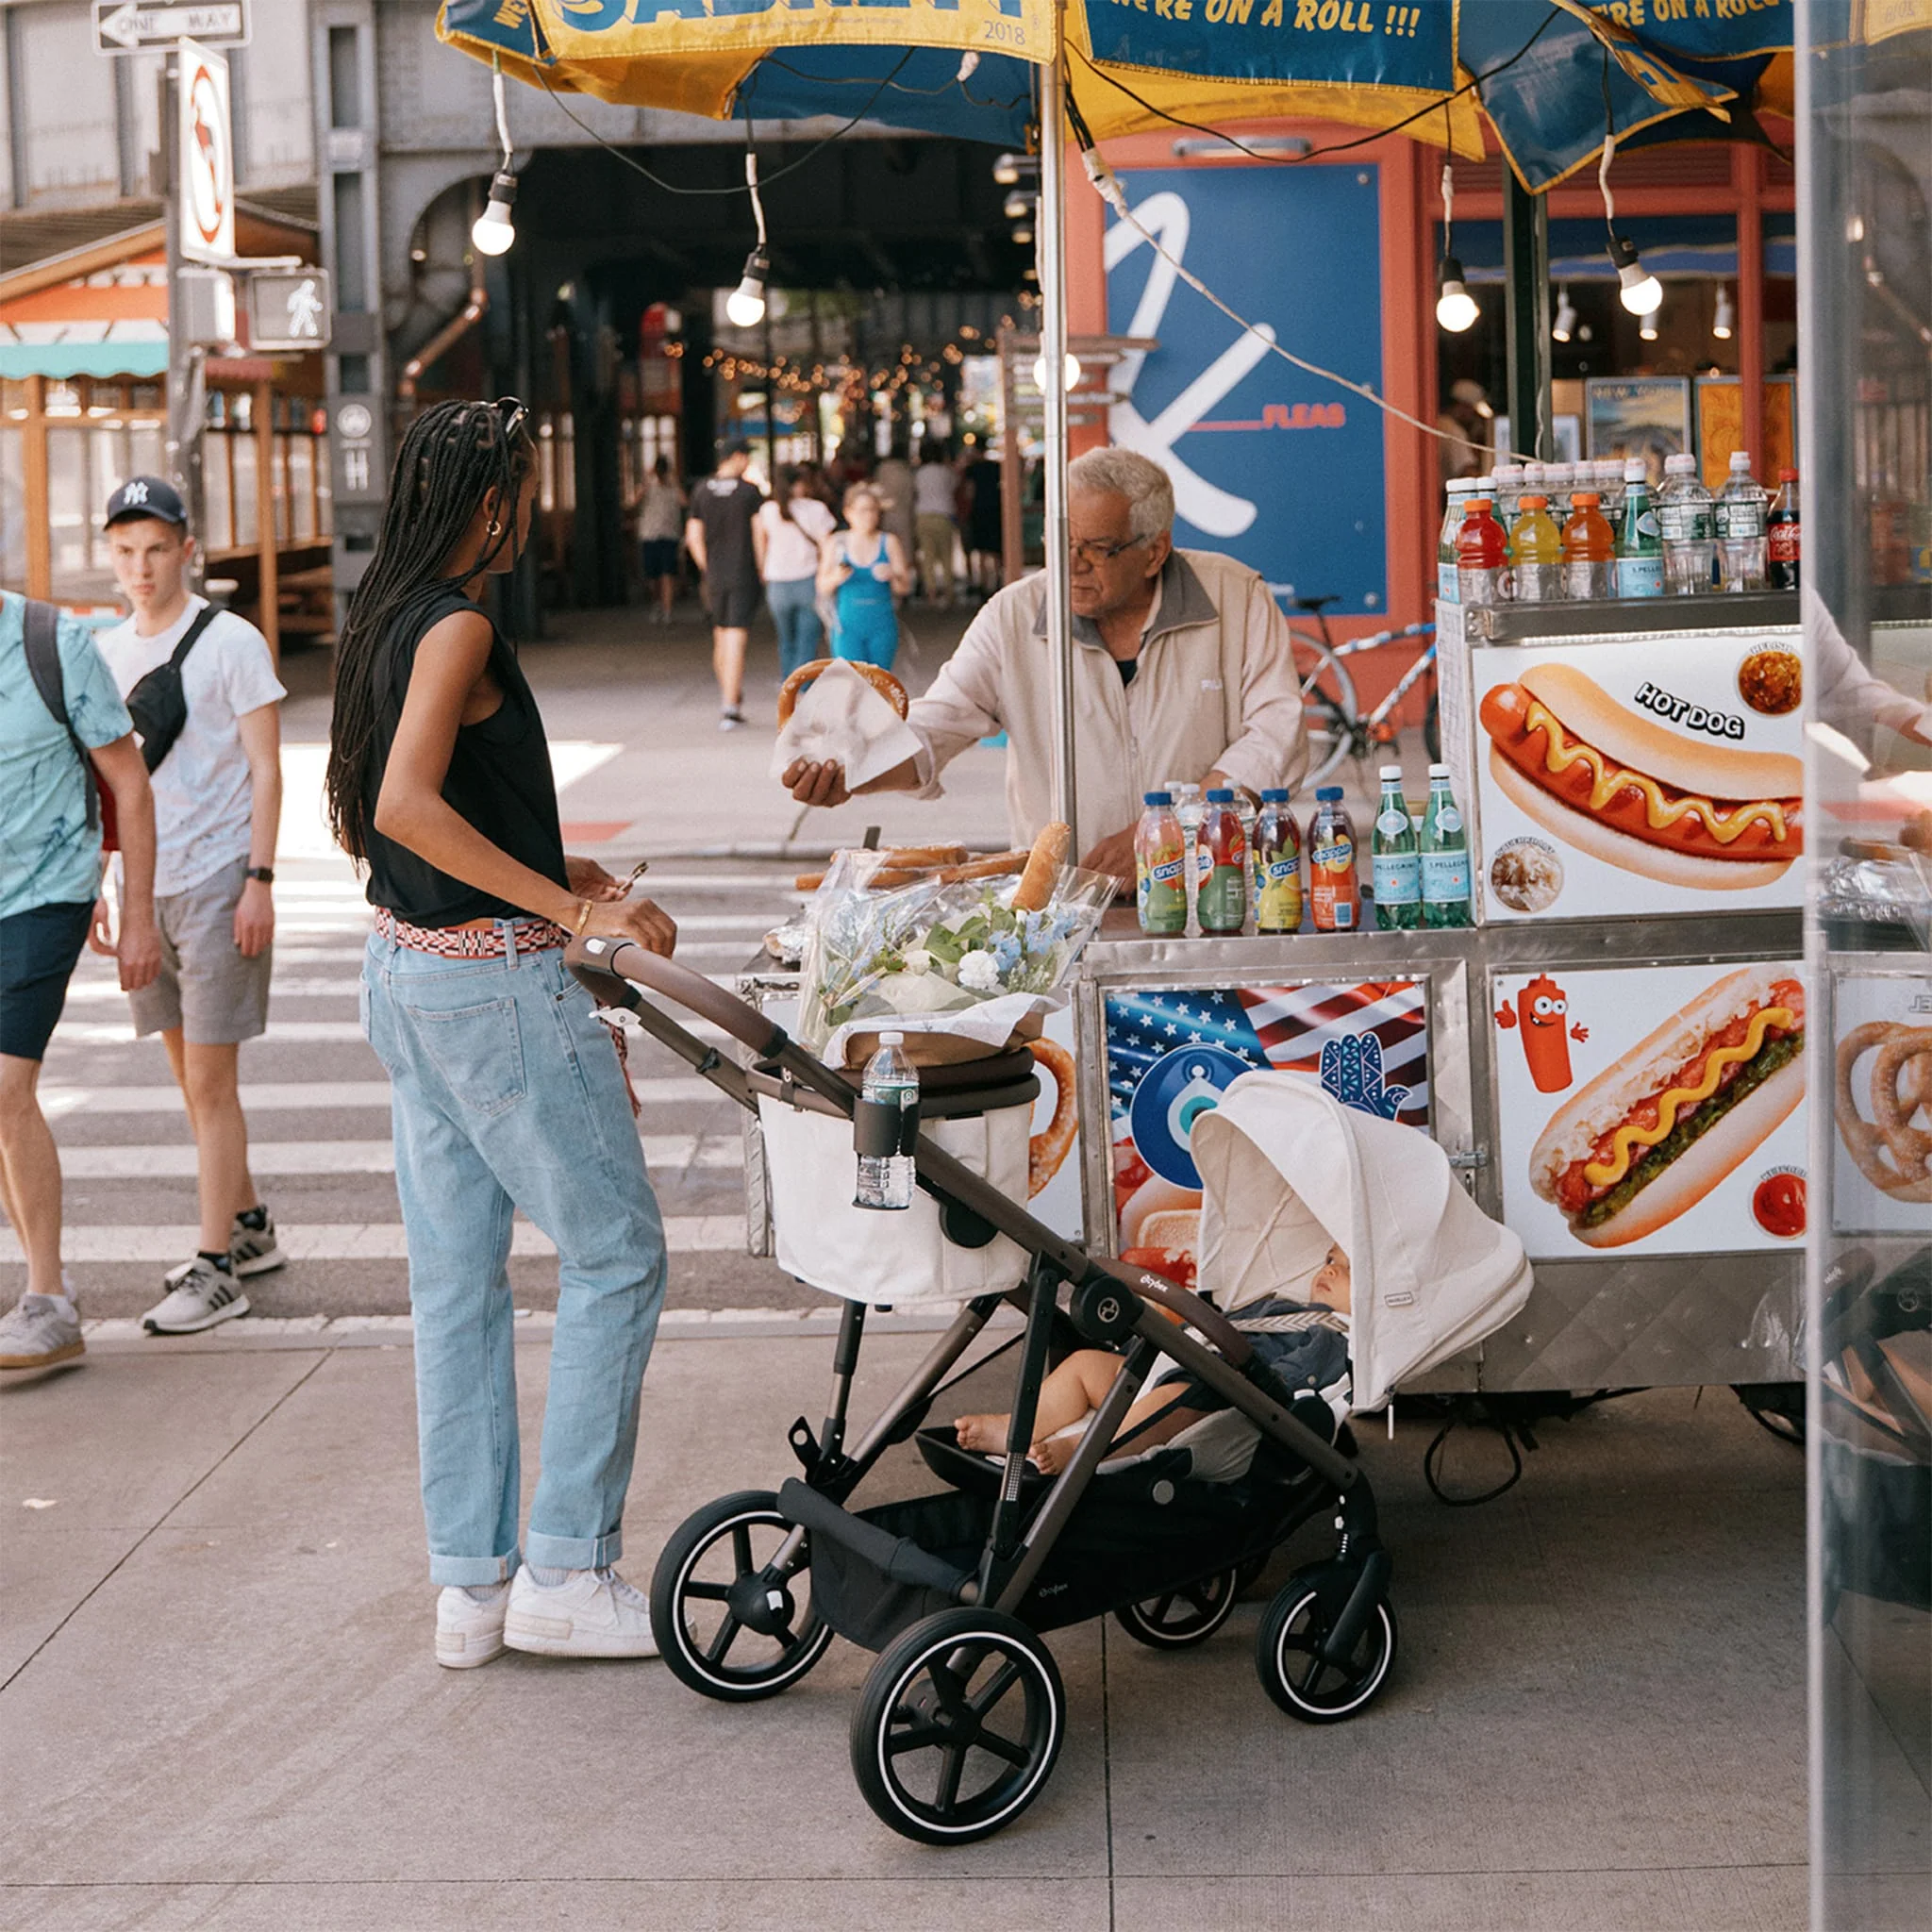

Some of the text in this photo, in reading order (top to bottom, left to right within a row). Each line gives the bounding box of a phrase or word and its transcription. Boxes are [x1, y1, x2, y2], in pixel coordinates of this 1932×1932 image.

[189, 12, 231, 27] WAY
[1205, 0, 1253, 25] ON
[1260, 0, 1283, 27] A
[1293, 1, 1374, 32] ROLL
[1385, 5, 1421, 38] !!!
[984, 21, 1026, 46] 2018
[1262, 403, 1346, 431] FLEAS
[1635, 681, 1745, 741] HOT DOG
